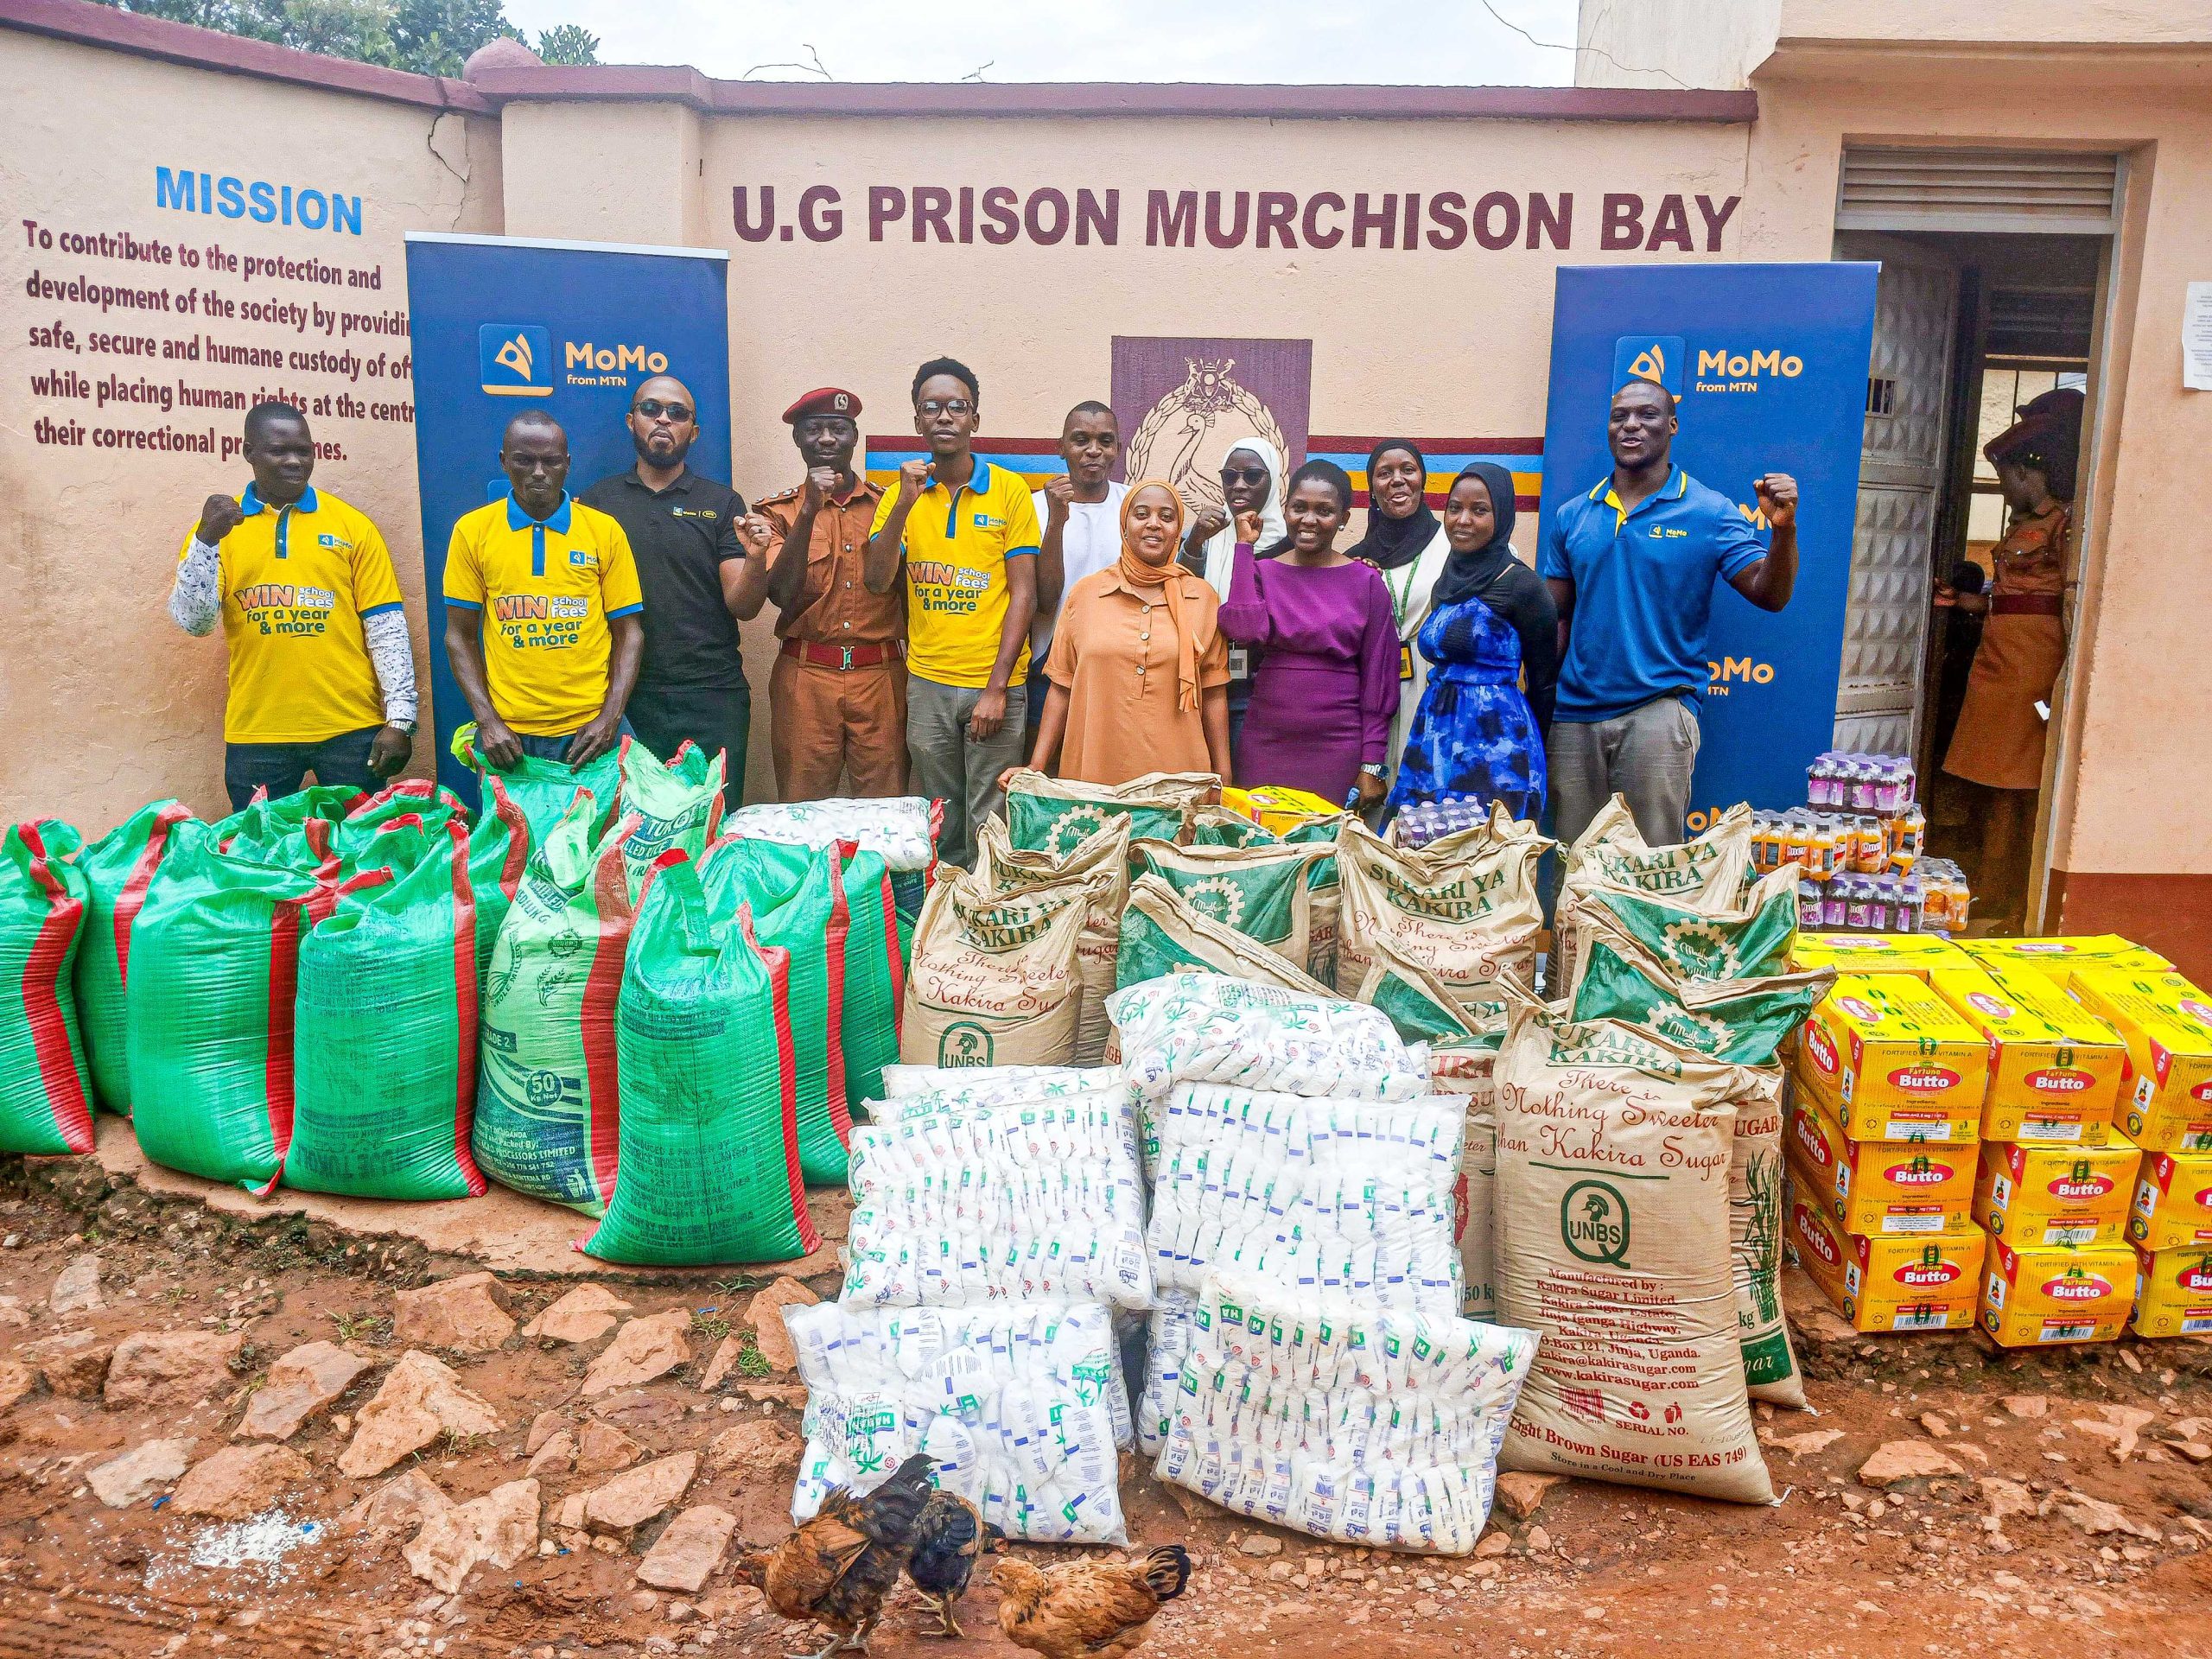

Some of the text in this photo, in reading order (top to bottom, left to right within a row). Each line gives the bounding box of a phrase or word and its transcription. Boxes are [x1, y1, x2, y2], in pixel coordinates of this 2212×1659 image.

[156, 166, 361, 236] MISSION
[733, 186, 1741, 252] U.G PRISON MURCHISON BAY
[22, 219, 382, 290] To contribute to the protection and
[27, 270, 169, 314] development
[175, 288, 197, 314] of
[203, 290, 234, 319] the
[240, 298, 308, 333] society
[314, 302, 335, 336] by
[29, 321, 385, 383] safe, secure and humane custody of
[565, 341, 669, 373] MoMo
[1697, 350, 1803, 378] MoMo
[567, 373, 627, 387] from MTN
[1695, 381, 1758, 393] from MTN
[31, 368, 90, 399] while
[97, 373, 173, 412] placing
[179, 379, 245, 410] human
[313, 394, 332, 416] at
[337, 393, 365, 419] the
[34, 416, 215, 454] their correctional
[907, 562, 955, 586] WIN
[955, 575, 989, 589] fees
[958, 567, 991, 580] school
[233, 584, 294, 611] WIN
[296, 597, 334, 608] fees
[299, 586, 334, 599] school
[552, 596, 588, 606] school
[915, 586, 982, 601] for a year
[923, 598, 976, 611] & more
[247, 609, 330, 623] for a year
[494, 595, 548, 621] WIN
[550, 607, 588, 619] fees
[260, 622, 325, 635] & more
[501, 620, 582, 636] for a year
[513, 632, 579, 648] & more
[1681, 842, 1719, 864] YA
[1370, 864, 1505, 899] SUKARI YA
[1387, 887, 1493, 919] KAKIRA
[960, 918, 1052, 948] KAKIRA
[1398, 916, 1453, 940] There
[912, 940, 988, 988] Nothing
[926, 976, 1006, 1012] Kakira
[504, 1037, 511, 1047] 2
[1533, 1011, 1656, 1058] SUKARI
[1548, 1039, 1682, 1078] KAKIRA
[1808, 1029, 1834, 1071] Butto
[531, 1073, 555, 1093] 50
[1559, 1070, 1631, 1095] There
[1899, 1074, 1949, 1088] Butto
[2035, 1077, 2085, 1090] Butto
[1502, 1082, 1609, 1133] Nothing
[1622, 1094, 1719, 1128] Sweeter
[1540, 1125, 1646, 1166] Kakira
[1660, 1135, 1727, 1181] Sugar
[1797, 1120, 1825, 1163] Butto
[1895, 1171, 1943, 1183] Butto
[2058, 1184, 2104, 1196] Butto
[1569, 1219, 1622, 1245] UNBS
[1800, 1213, 1833, 1262] Butto
[1548, 1268, 1656, 1293] Manufactured by
[1904, 1271, 1950, 1283] Butto
[1465, 1285, 1480, 1301] 50
[1536, 1279, 1577, 1296] Kakira
[1580, 1286, 1620, 1300] Sugar
[2052, 1285, 2101, 1298] Butto
[1541, 1294, 1583, 1310] Kakira
[1586, 1300, 1624, 1314] Sugar
[1539, 1307, 1681, 1335] Jinja Iganga Highway,
[1738, 1311, 1754, 1329] kg
[1580, 1339, 1700, 1361] 121, Jinja, Uganda.
[1541, 1365, 1700, 1391] www.kakirasugar.com
[1616, 1420, 1689, 1436] SERIAL NO.
[1510, 1415, 1542, 1440] Light
[1545, 1427, 1595, 1457] Brown
[1600, 1444, 1649, 1465] Sugar
[1654, 1453, 1683, 1467] (US
[1688, 1453, 1721, 1467] EAS
[1725, 1445, 1746, 1465] 749)
[1551, 1452, 1577, 1467] Store
[1601, 1464, 1624, 1474] Cool
[1625, 1467, 1645, 1477] and
[1648, 1470, 1666, 1480] Dry
[1669, 1471, 1696, 1481] Place
